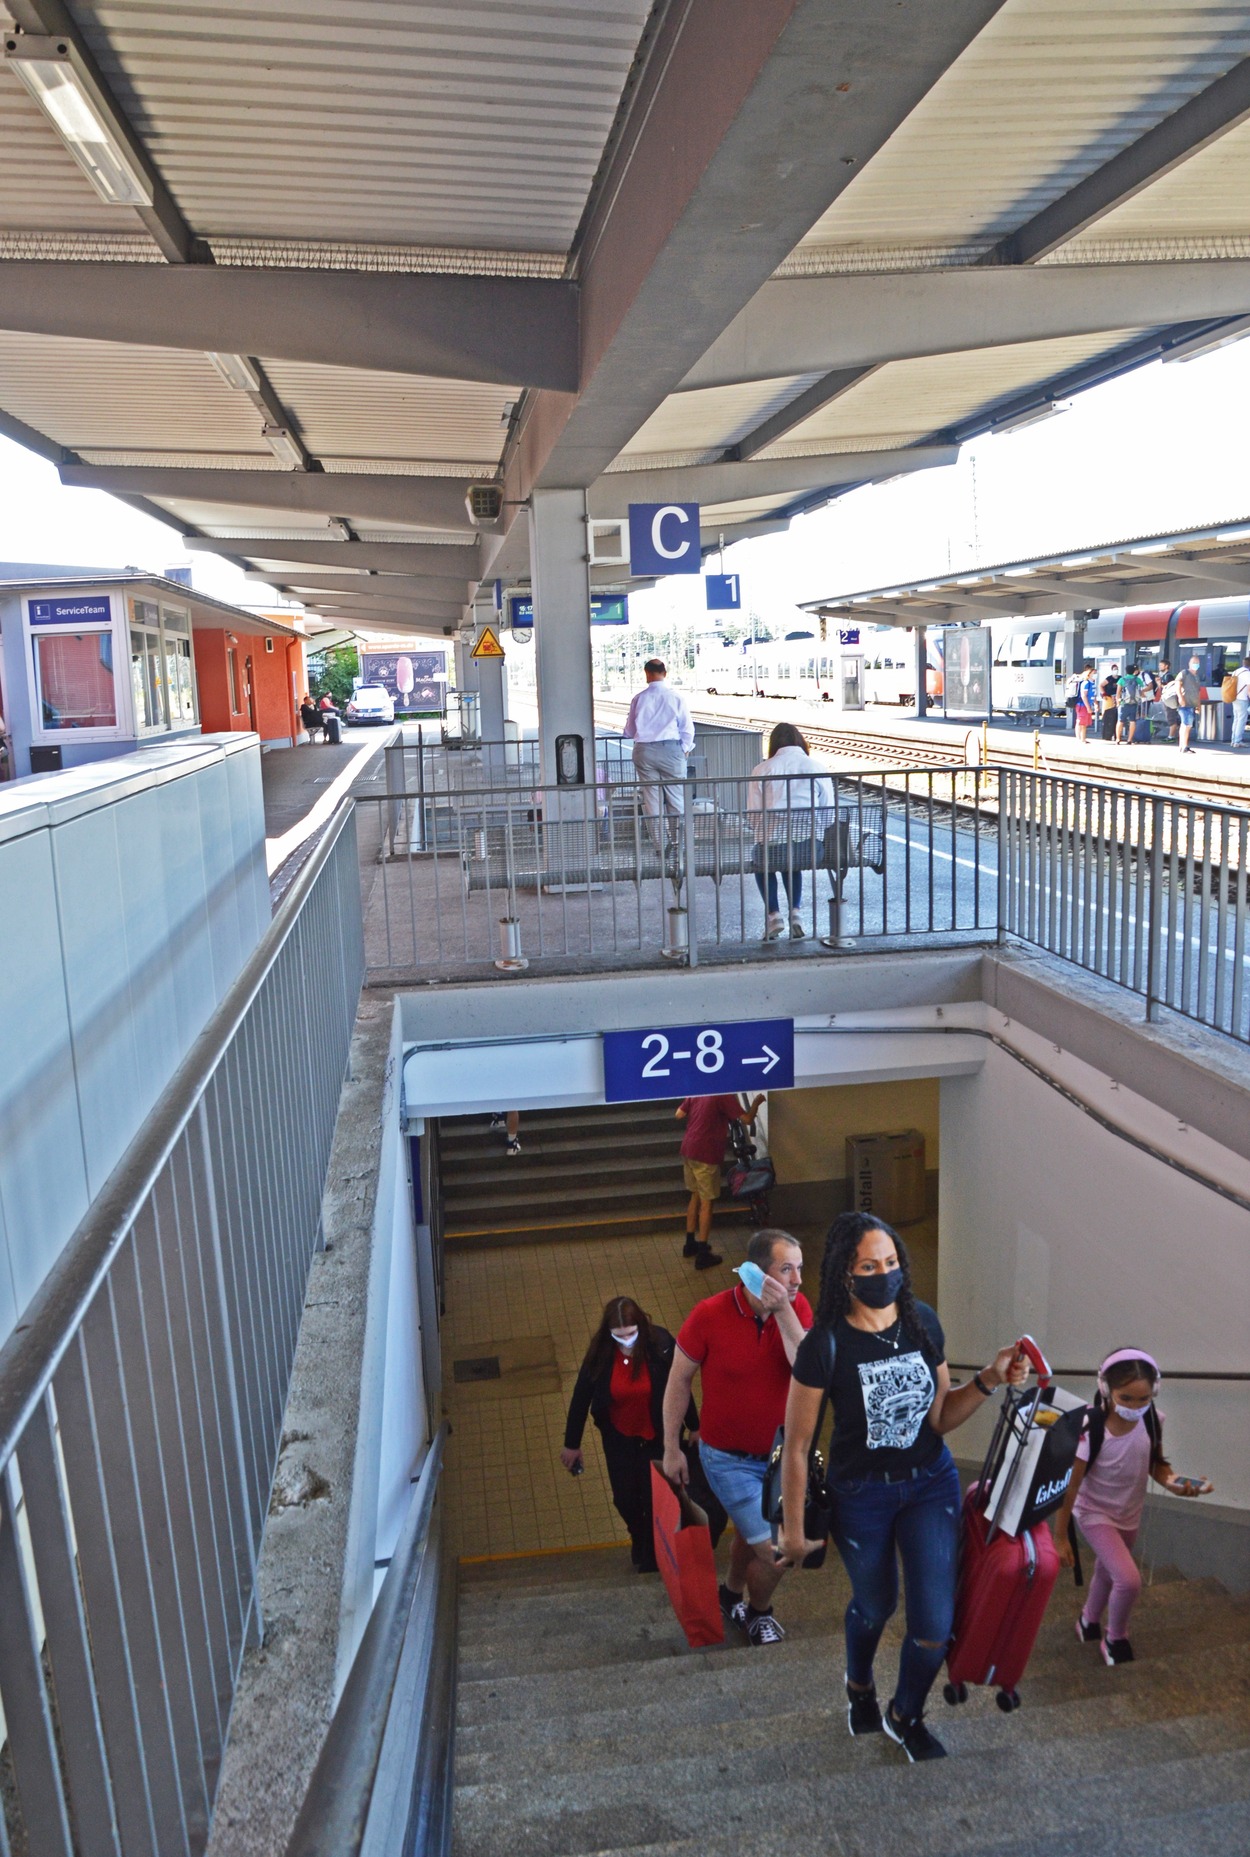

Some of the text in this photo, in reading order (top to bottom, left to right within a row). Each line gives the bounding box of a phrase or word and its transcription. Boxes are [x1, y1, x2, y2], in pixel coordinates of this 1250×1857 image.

[651, 506, 690, 559] C
[725, 575, 737, 602] 1
[56, 606, 105, 616] ServiceTeam
[841, 631, 849, 643] 2
[641, 1029, 725, 1078] 2-8
